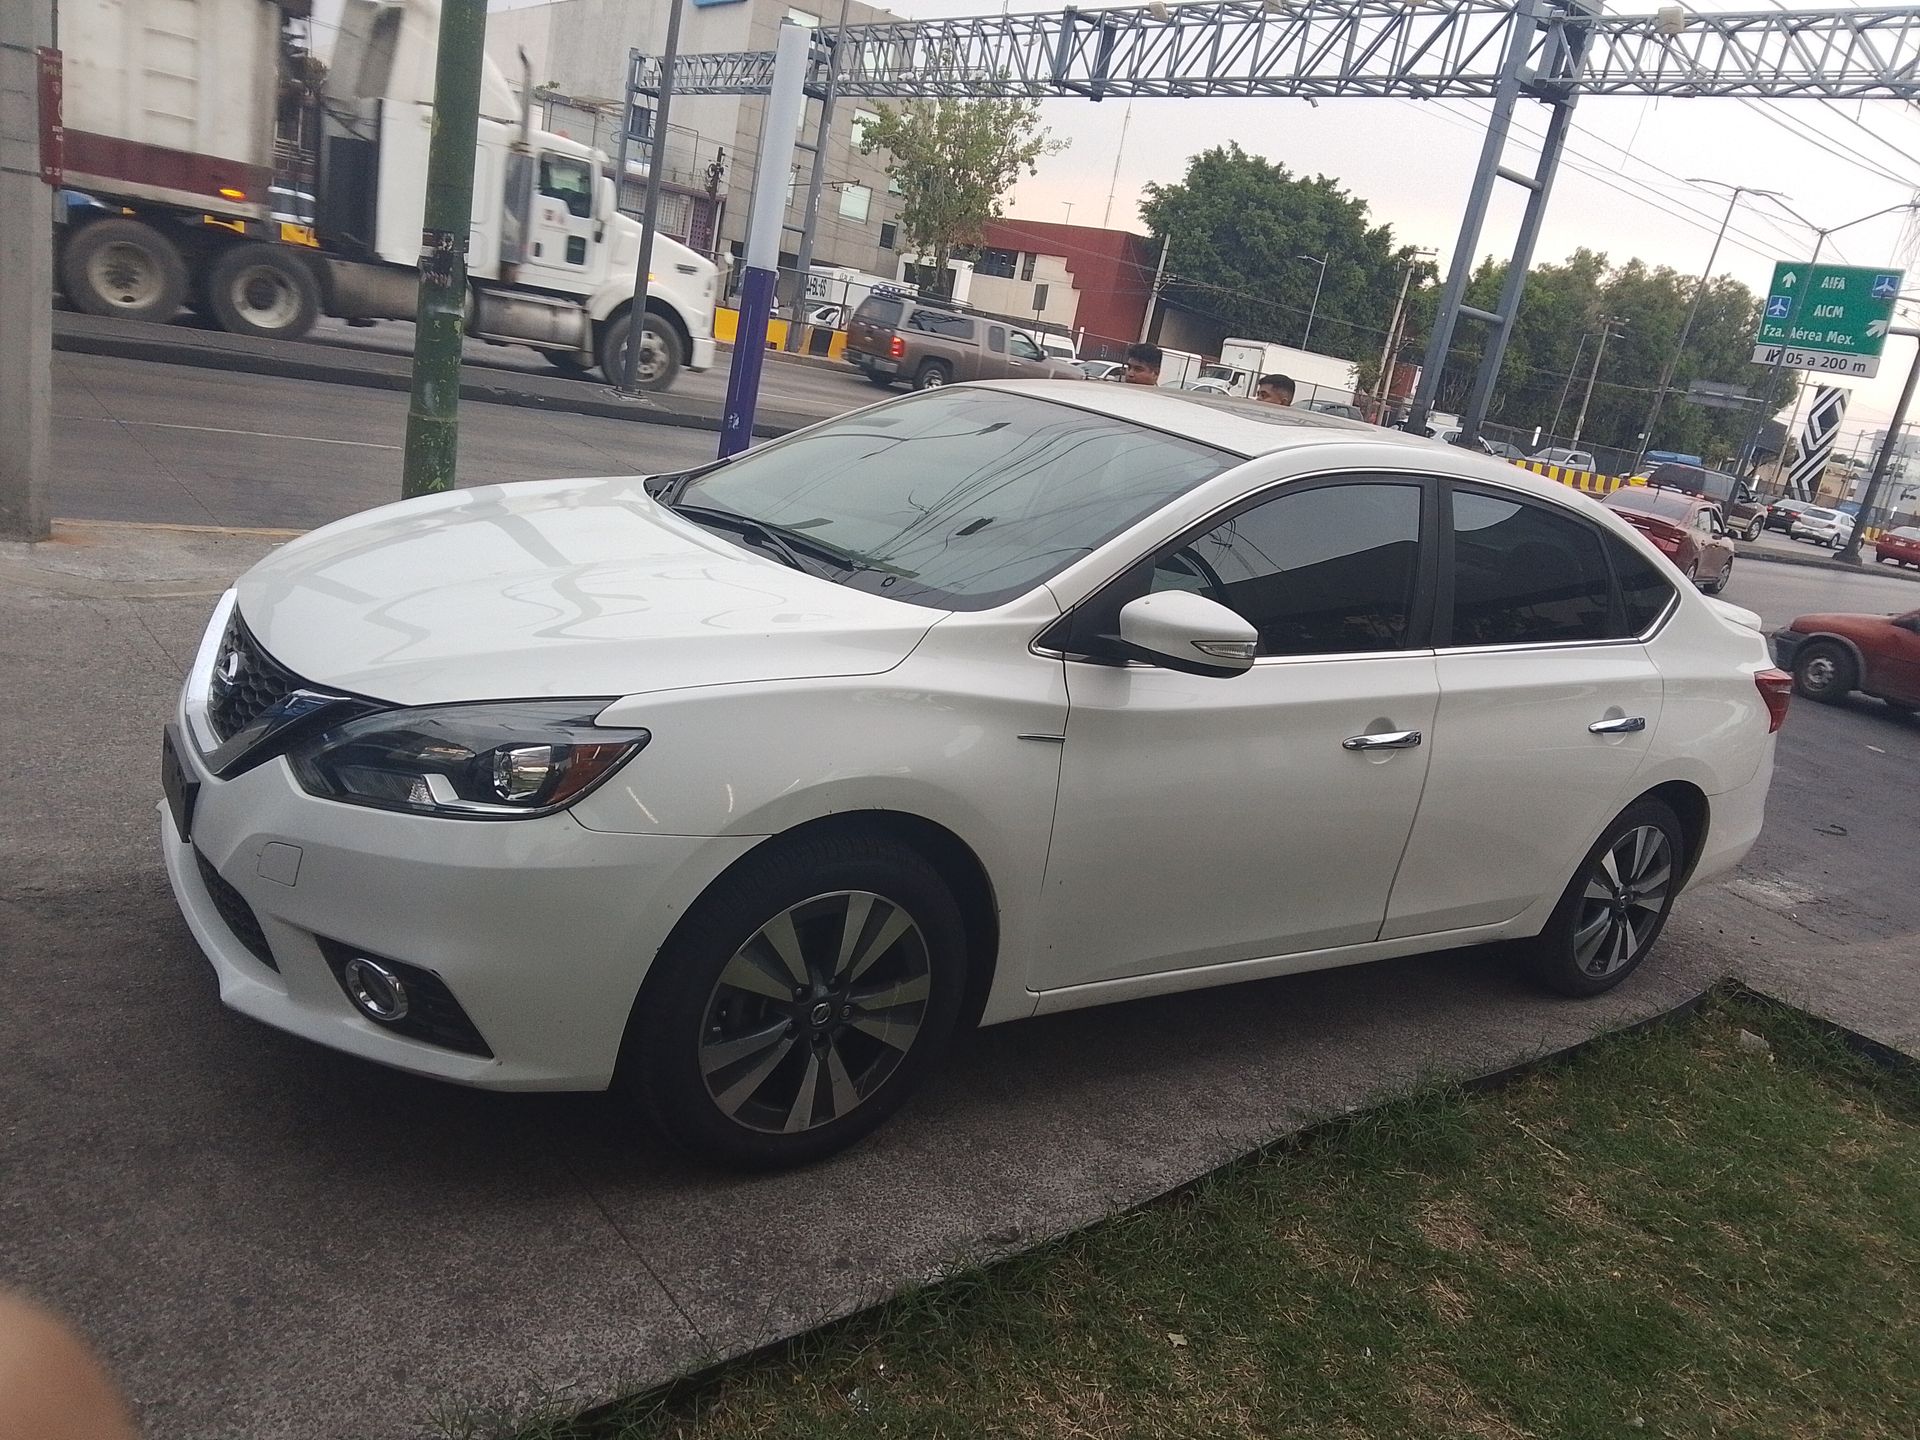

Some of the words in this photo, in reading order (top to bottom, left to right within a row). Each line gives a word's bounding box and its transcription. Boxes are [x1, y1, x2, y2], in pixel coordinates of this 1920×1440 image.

[1821, 276, 1846, 290] AIFA
[1813, 305, 1844, 318] AICM
[1763, 324, 1785, 338] Fza.
[1789, 326, 1822, 342] Aérea
[1826, 331, 1855, 346] Mex.
[1786, 352, 1803, 365] 05
[1807, 357, 1816, 366] a
[1820, 356, 1848, 370] 200
[1852, 362, 1866, 373] m
